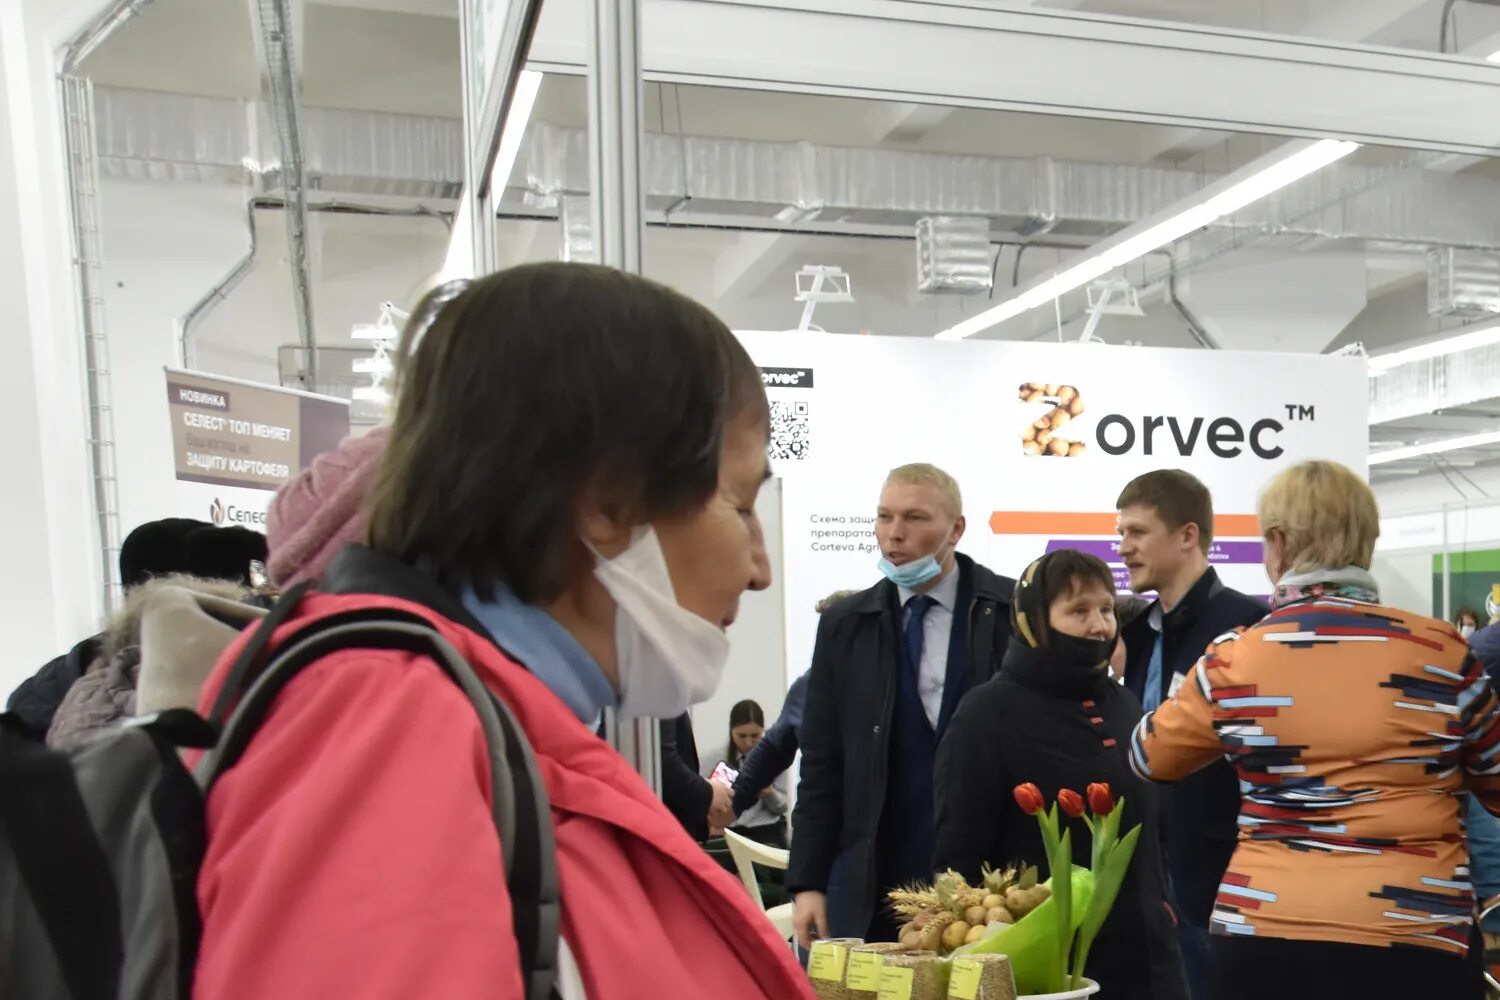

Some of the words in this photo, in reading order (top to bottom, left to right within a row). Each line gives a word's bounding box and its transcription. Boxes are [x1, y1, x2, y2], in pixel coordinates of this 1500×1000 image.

[180, 389, 226, 408] НОВИНКА
[229, 419, 251, 435] ТОП
[252, 423, 292, 442] МЕНЯЕТ
[186, 452, 229, 472] ЗАЩИТУ
[229, 460, 290, 479] КАРТОФЕЛЯ
[227, 505, 267, 524] Селес
[810, 513, 846, 524] Схема
[810, 542, 855, 552] Corteva
